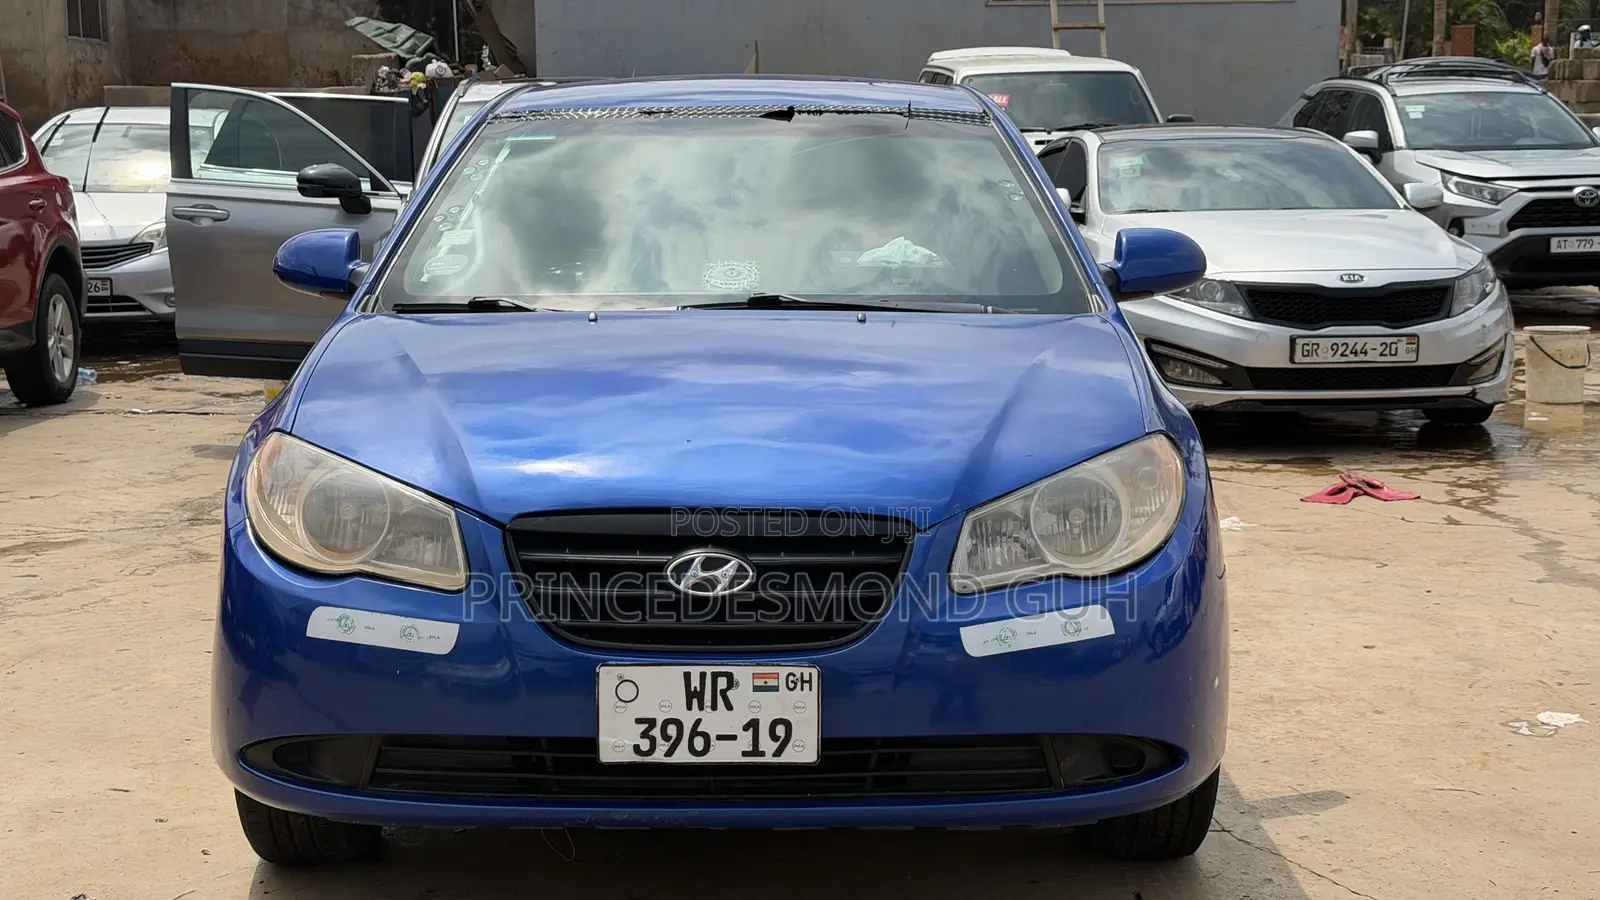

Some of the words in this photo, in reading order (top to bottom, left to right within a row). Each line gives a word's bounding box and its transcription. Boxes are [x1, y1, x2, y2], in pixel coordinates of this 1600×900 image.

[1556, 239, 1568, 250] AT
[1341, 273, 1364, 282] KIA
[1301, 342, 1320, 358] GR
[1330, 341, 1399, 358] 9244-20
[1405, 347, 1416, 355] GH
[683, 670, 734, 712] WR
[785, 672, 813, 692] GH
[632, 717, 793, 758] 396-19
